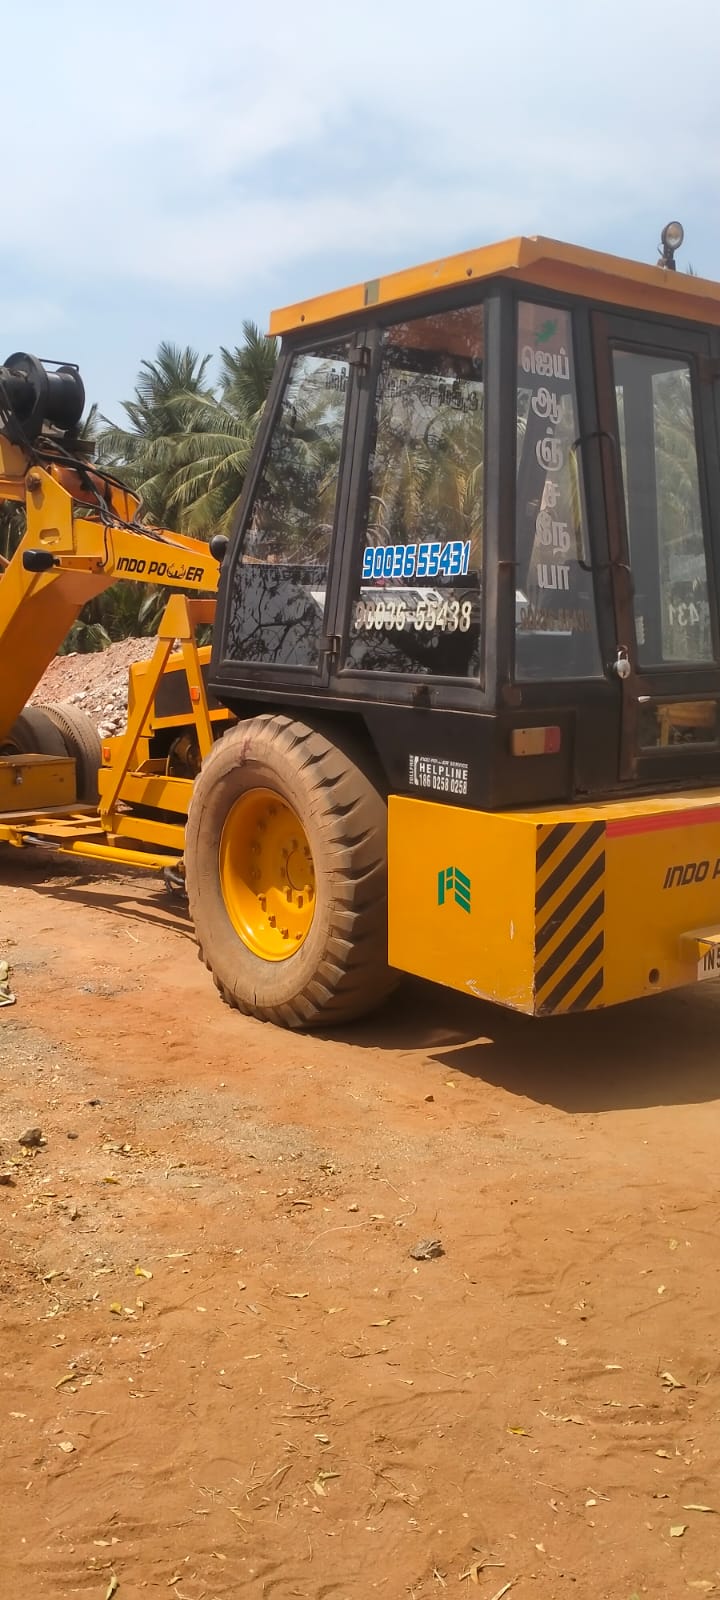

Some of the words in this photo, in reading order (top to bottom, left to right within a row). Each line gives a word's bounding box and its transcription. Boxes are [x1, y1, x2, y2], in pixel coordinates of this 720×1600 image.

[116, 557, 146, 573] INDO
[362, 545, 417, 579] 90036
[416, 540, 471, 577] 55431
[419, 762, 468, 781] HELPLINE
[419, 773, 431, 788] 186
[432, 775, 449, 792] 0258
[450, 778, 468, 795] 0258
[663, 860, 710, 889] INDO
